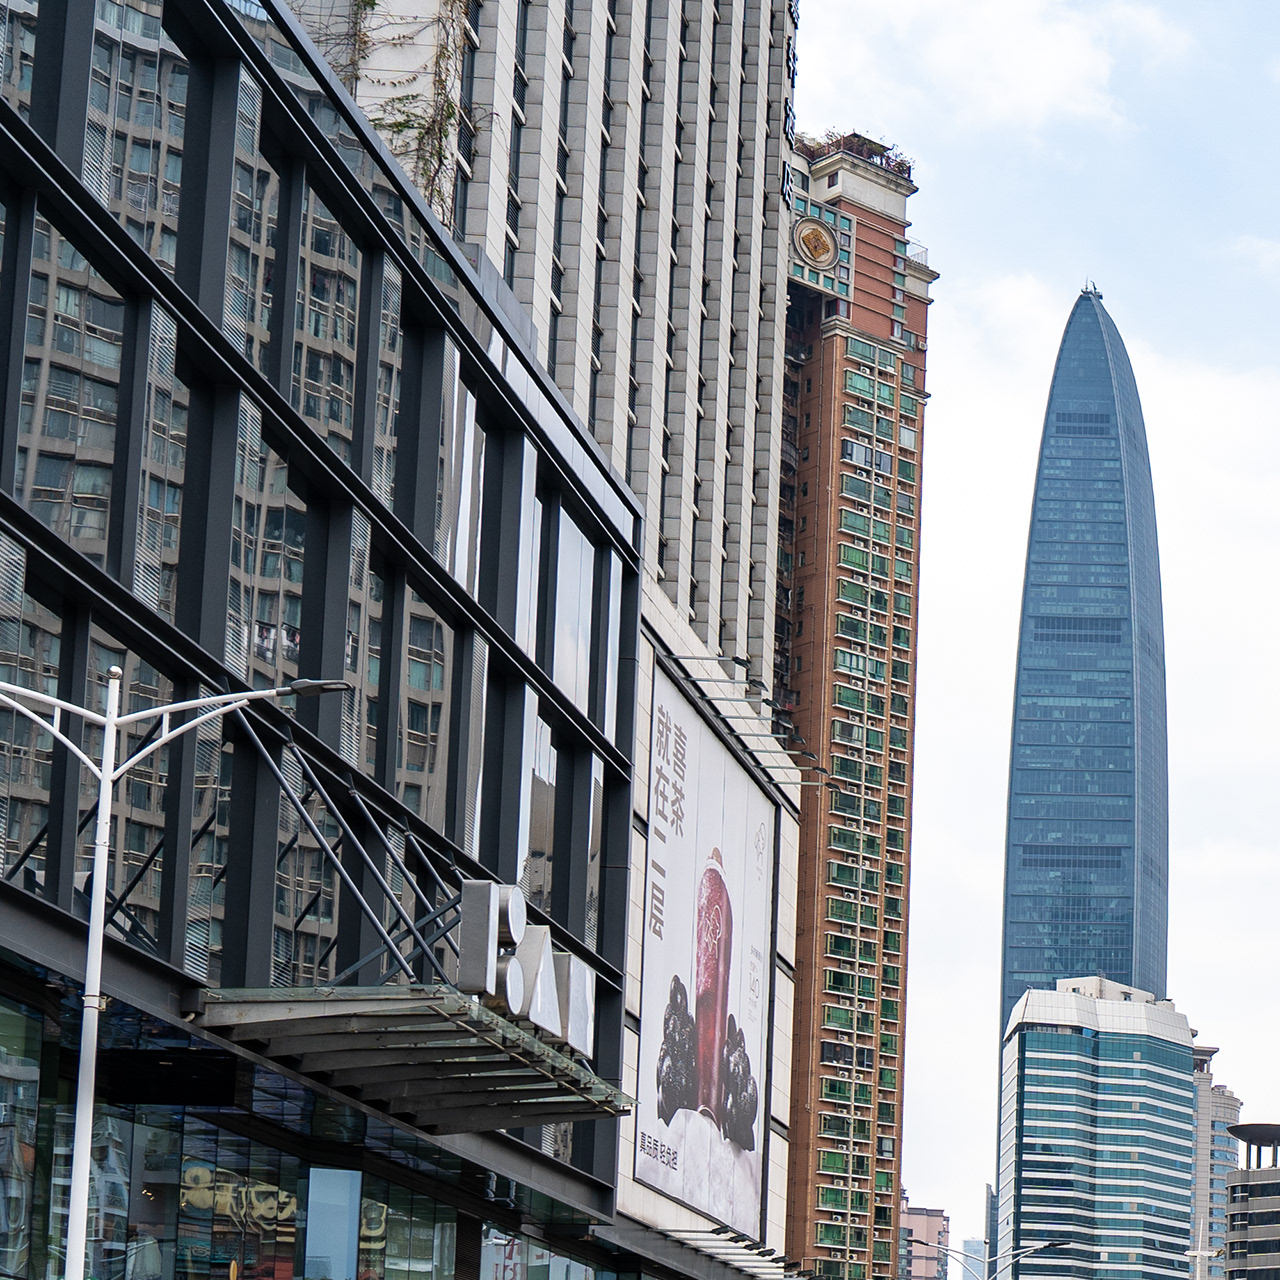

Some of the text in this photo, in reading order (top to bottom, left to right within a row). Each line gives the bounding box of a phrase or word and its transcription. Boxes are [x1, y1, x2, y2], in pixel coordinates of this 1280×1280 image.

[650, 704, 672, 941] 就在二层
[671, 722, 687, 838] 喜茶
[640, 1131, 678, 1171] 真品质 轻负担
